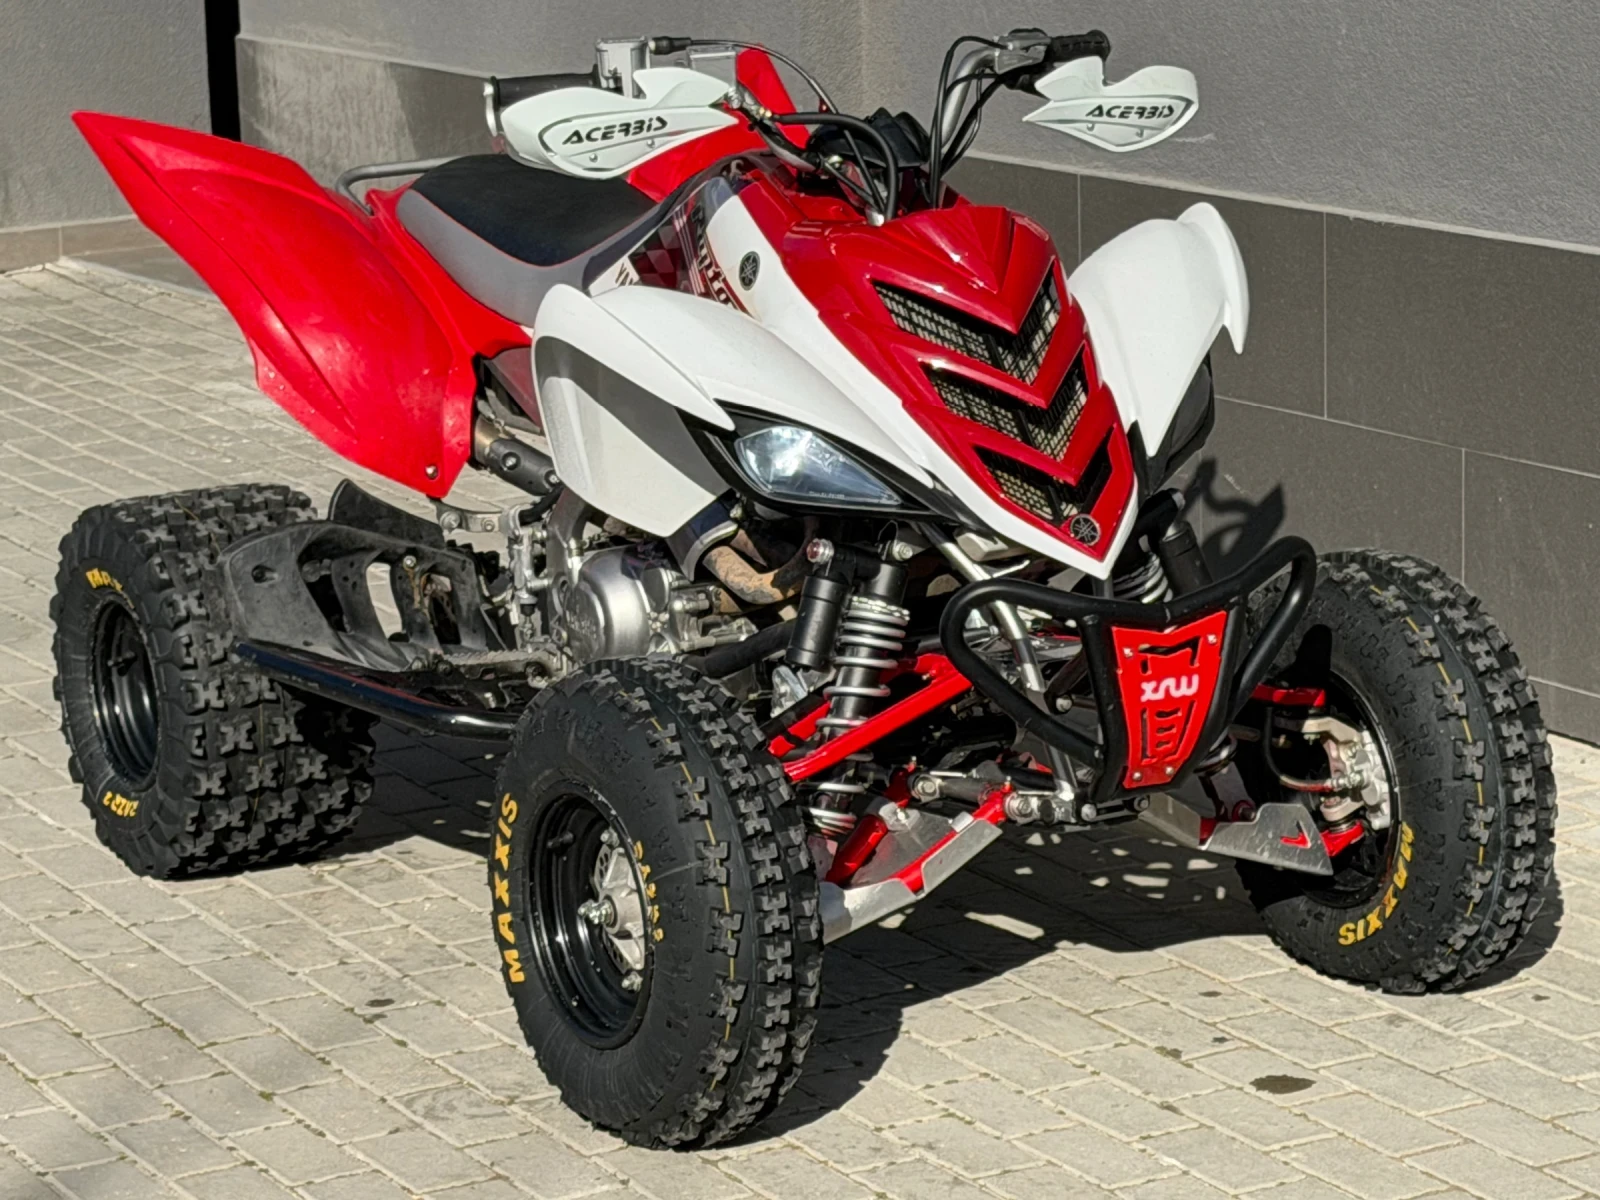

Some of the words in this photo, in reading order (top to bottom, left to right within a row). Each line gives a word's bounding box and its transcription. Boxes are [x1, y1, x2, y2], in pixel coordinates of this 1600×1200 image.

[562, 116, 669, 146] ACERBIS
[1085, 104, 1175, 119] ACERBIS
[494, 792, 525, 984] MAXXIS
[1337, 821, 1415, 946] MAXXIS
